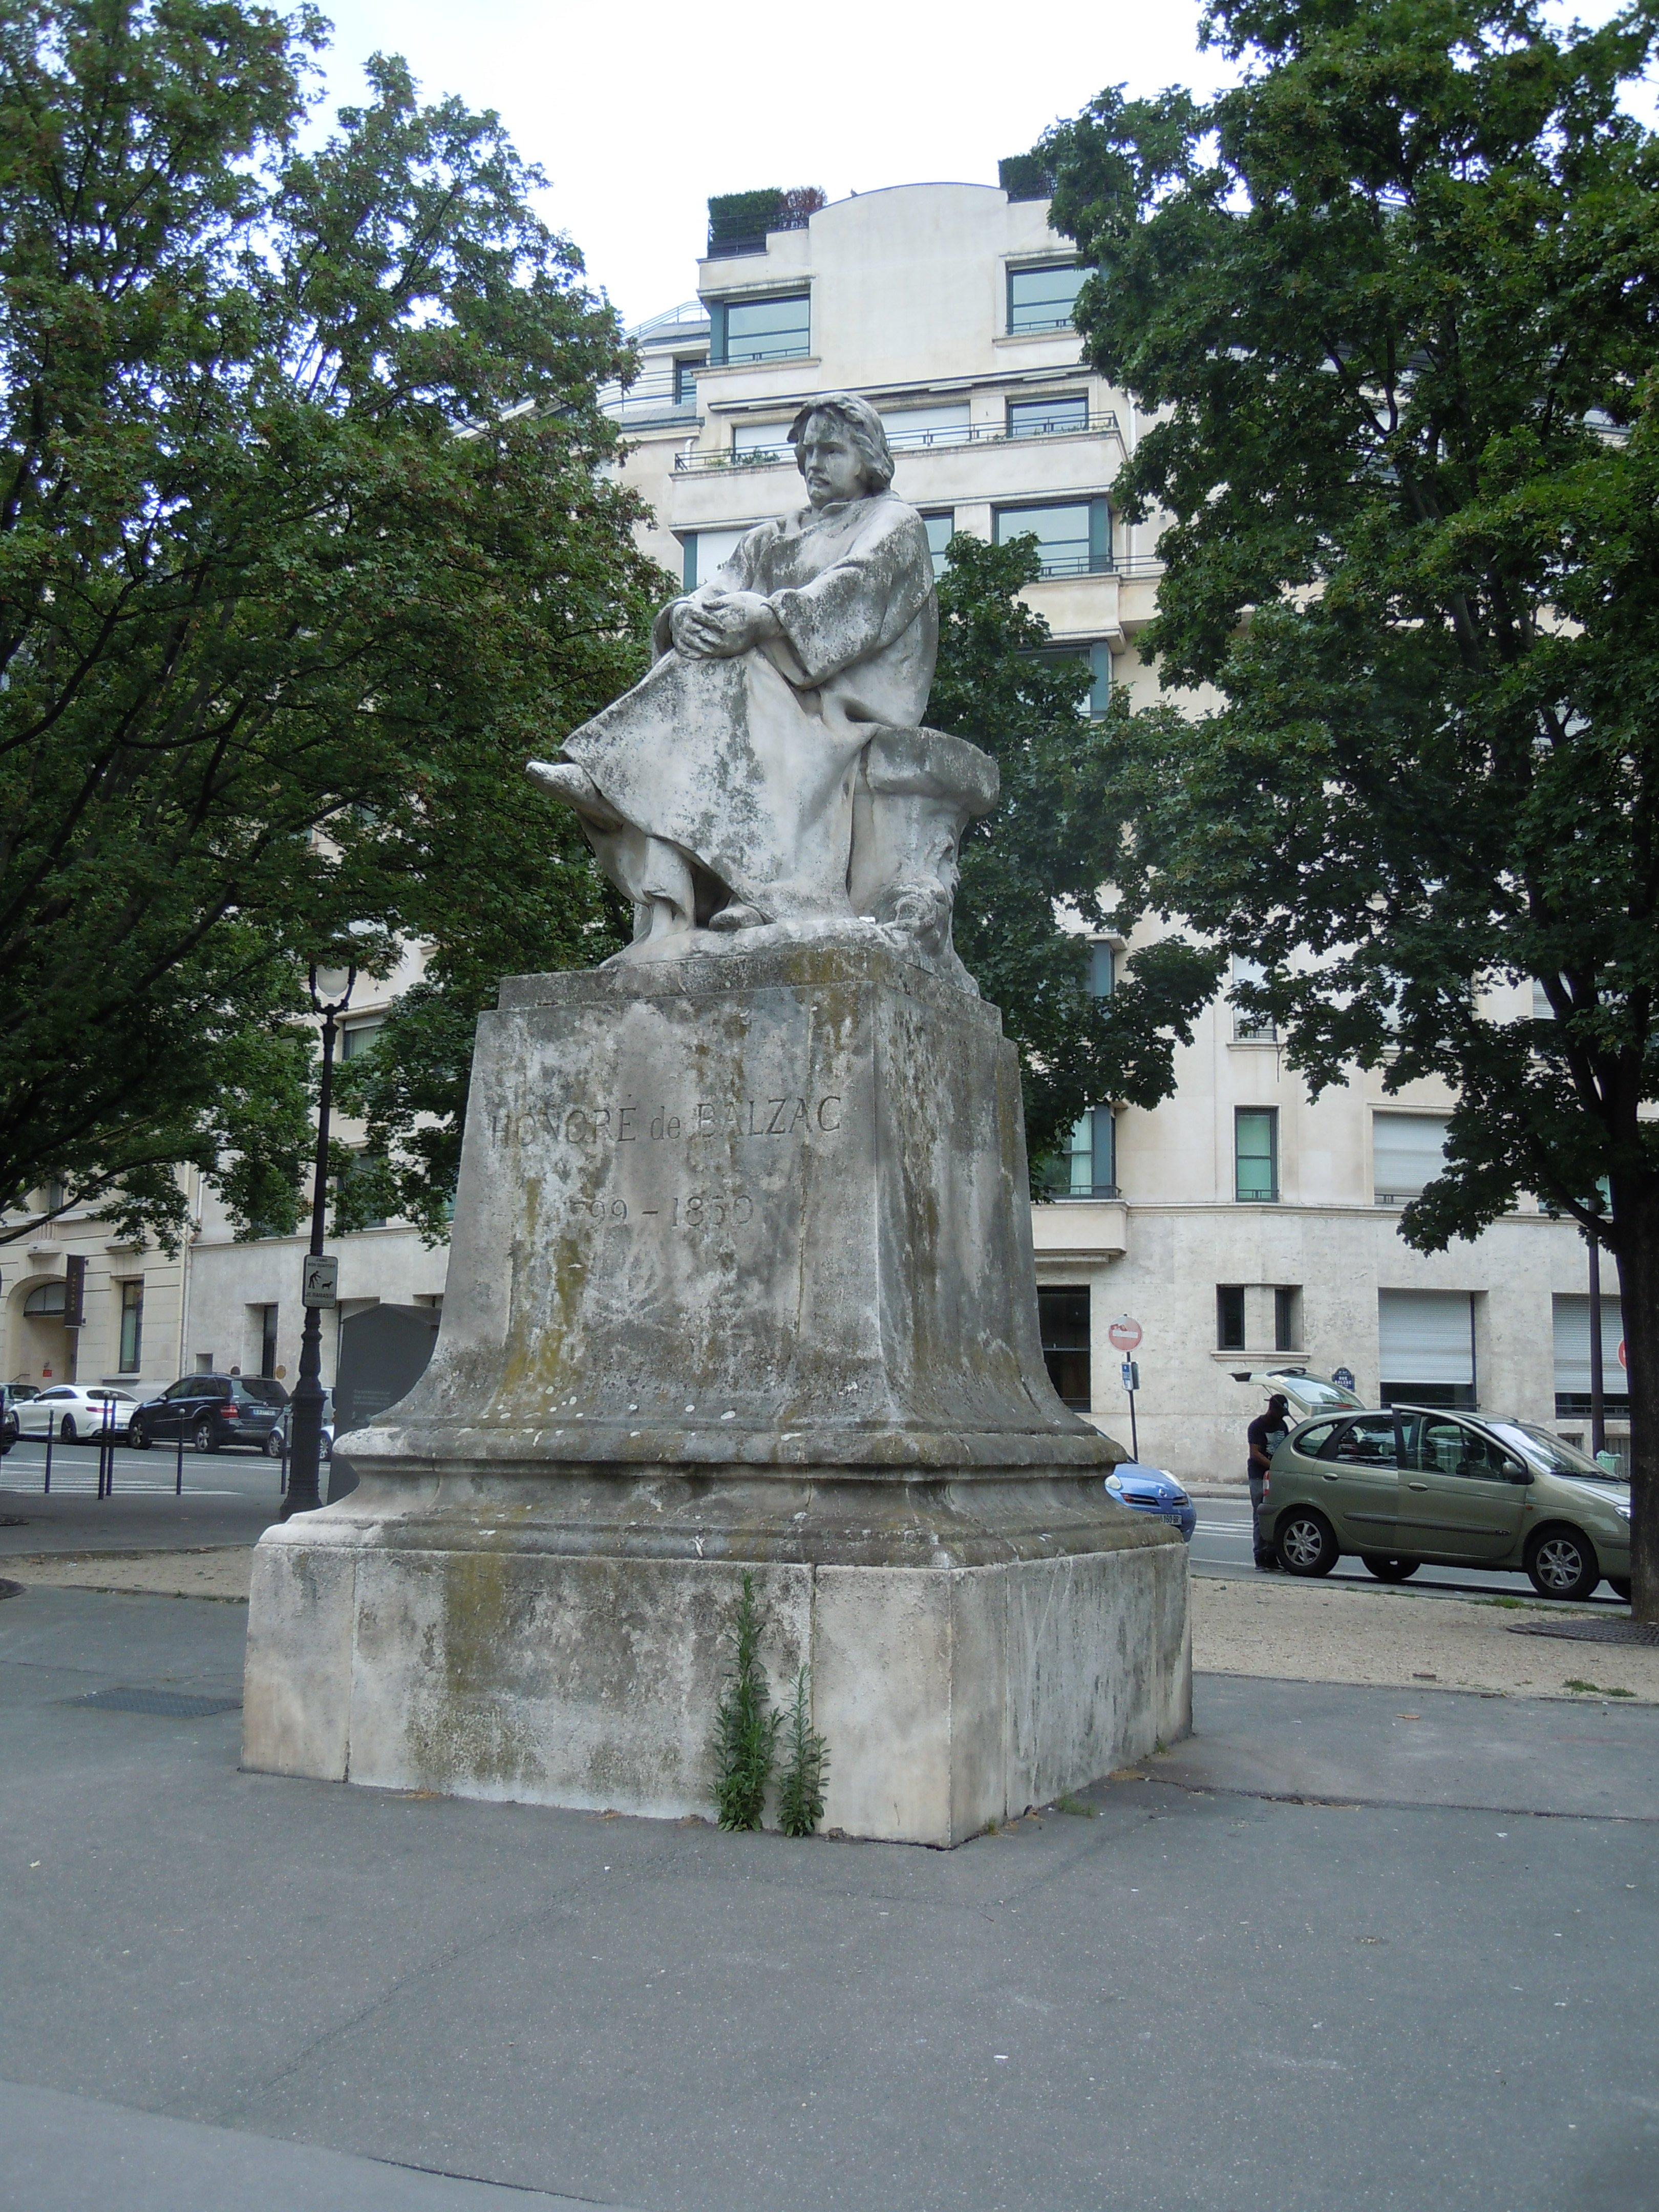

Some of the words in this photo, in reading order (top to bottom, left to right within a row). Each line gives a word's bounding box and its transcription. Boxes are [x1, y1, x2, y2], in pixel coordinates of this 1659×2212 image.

[650, 1105, 680, 1140] de
[696, 1095, 841, 1138] BALZAC
[673, 1195, 754, 1227] 1850
